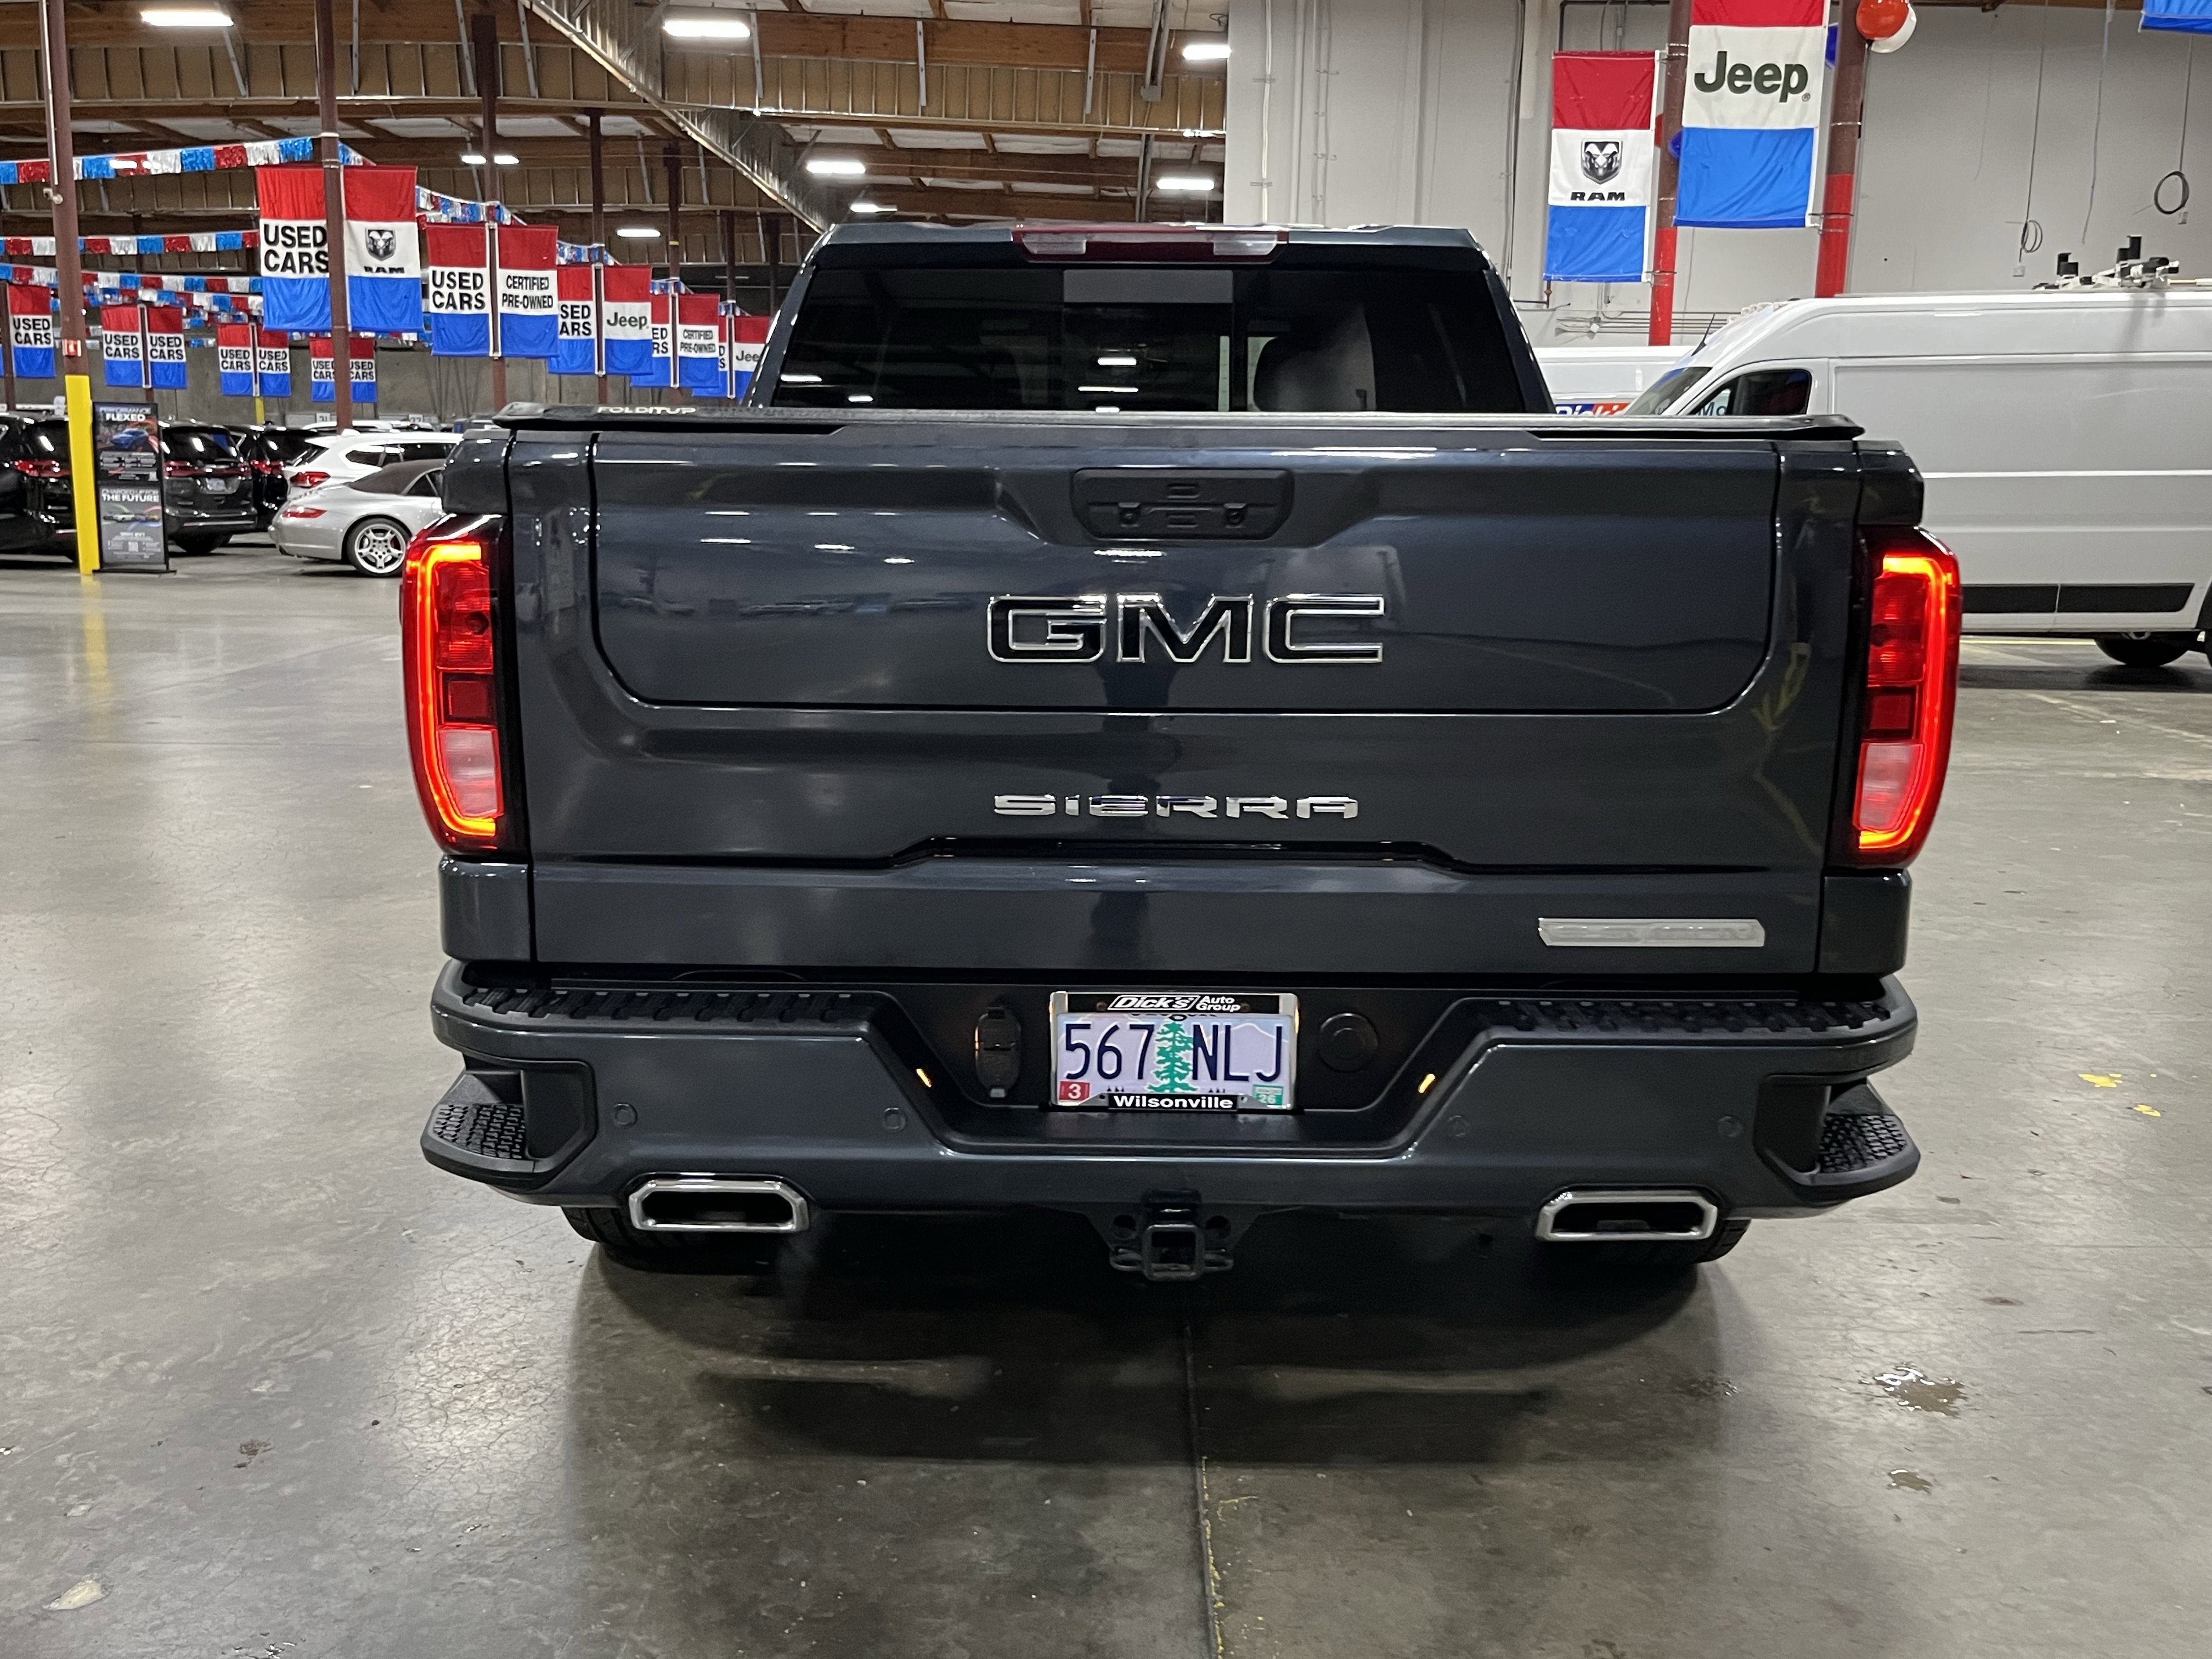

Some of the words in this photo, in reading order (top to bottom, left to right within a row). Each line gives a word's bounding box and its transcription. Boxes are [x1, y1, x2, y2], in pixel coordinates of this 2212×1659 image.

[1694, 51, 1808, 103] Jeep
[1570, 192, 1625, 201] RAM
[263, 224, 328, 248] USED
[264, 249, 329, 274] CARS
[432, 270, 483, 290] USED
[506, 275, 549, 290] CERTIFIED
[432, 291, 486, 310] CARS
[502, 294, 554, 309] PRE-OWNED
[560, 304, 591, 319] SED
[13, 318, 50, 330] USED
[606, 312, 648, 330] Jeep
[560, 321, 592, 336] ARS
[651, 328, 668, 340] ED
[14, 332, 52, 345] CARS
[104, 334, 138, 346] USED
[150, 336, 182, 348] USED
[105, 346, 140, 358] CARS
[652, 341, 669, 354] RS
[149, 348, 184, 360] CARS
[221, 349, 250, 360] USED
[258, 349, 287, 361] USED
[735, 350, 760, 362] Jee
[221, 360, 251, 371] CARS
[258, 360, 288, 371] CARS
[313, 371, 335, 380] CAR
[105, 413, 146, 421] FLEXED
[122, 494, 160, 503] FUTURE
[988, 592, 1385, 663] GMC
[994, 794, 1358, 819] SIERRA
[1114, 996, 1194, 1008] Dick's
[1199, 996, 1235, 1004] Auto
[1195, 1003, 1241, 1012] Group
[1065, 1024, 1154, 1080] 567
[1192, 1024, 1283, 1082] NLJ
[1068, 1084, 1081, 1099] 3
[1113, 1095, 1233, 1109] Wilsonville
[1258, 1094, 1277, 1104] 26
